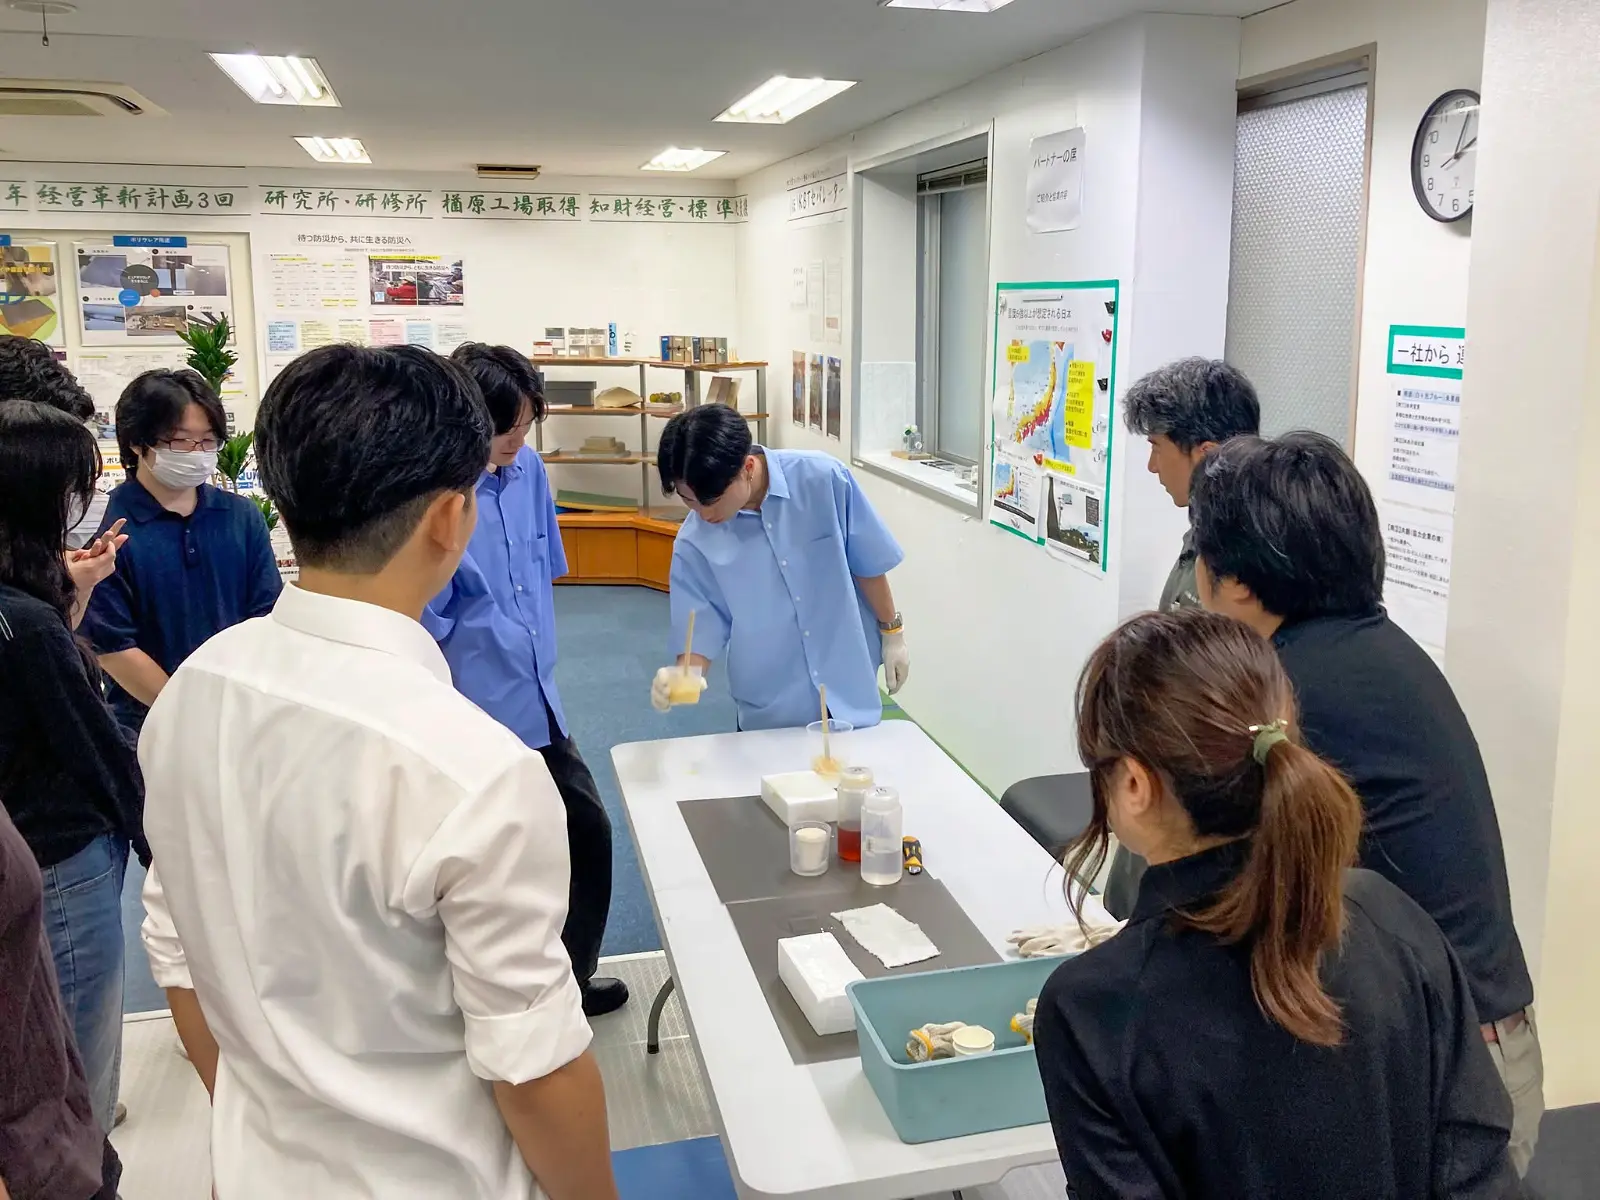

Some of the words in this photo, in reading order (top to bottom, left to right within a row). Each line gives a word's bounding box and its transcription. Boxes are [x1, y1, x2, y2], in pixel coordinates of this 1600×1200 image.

[1428, 130, 1439, 144] 10
[1423, 154, 1430, 167] 9
[1427, 178, 1434, 190] 8
[5, 184, 27, 206] 年
[37, 184, 234, 209] 経営革新計画3回
[264, 189, 427, 214] 研究所・研修所
[1438, 194, 1444, 206] 7
[1452, 199, 1459, 212] 6
[298, 234, 412, 245] 待つ防災から、共に生きる防災へ
[1398, 342, 1450, 364] 一社から
